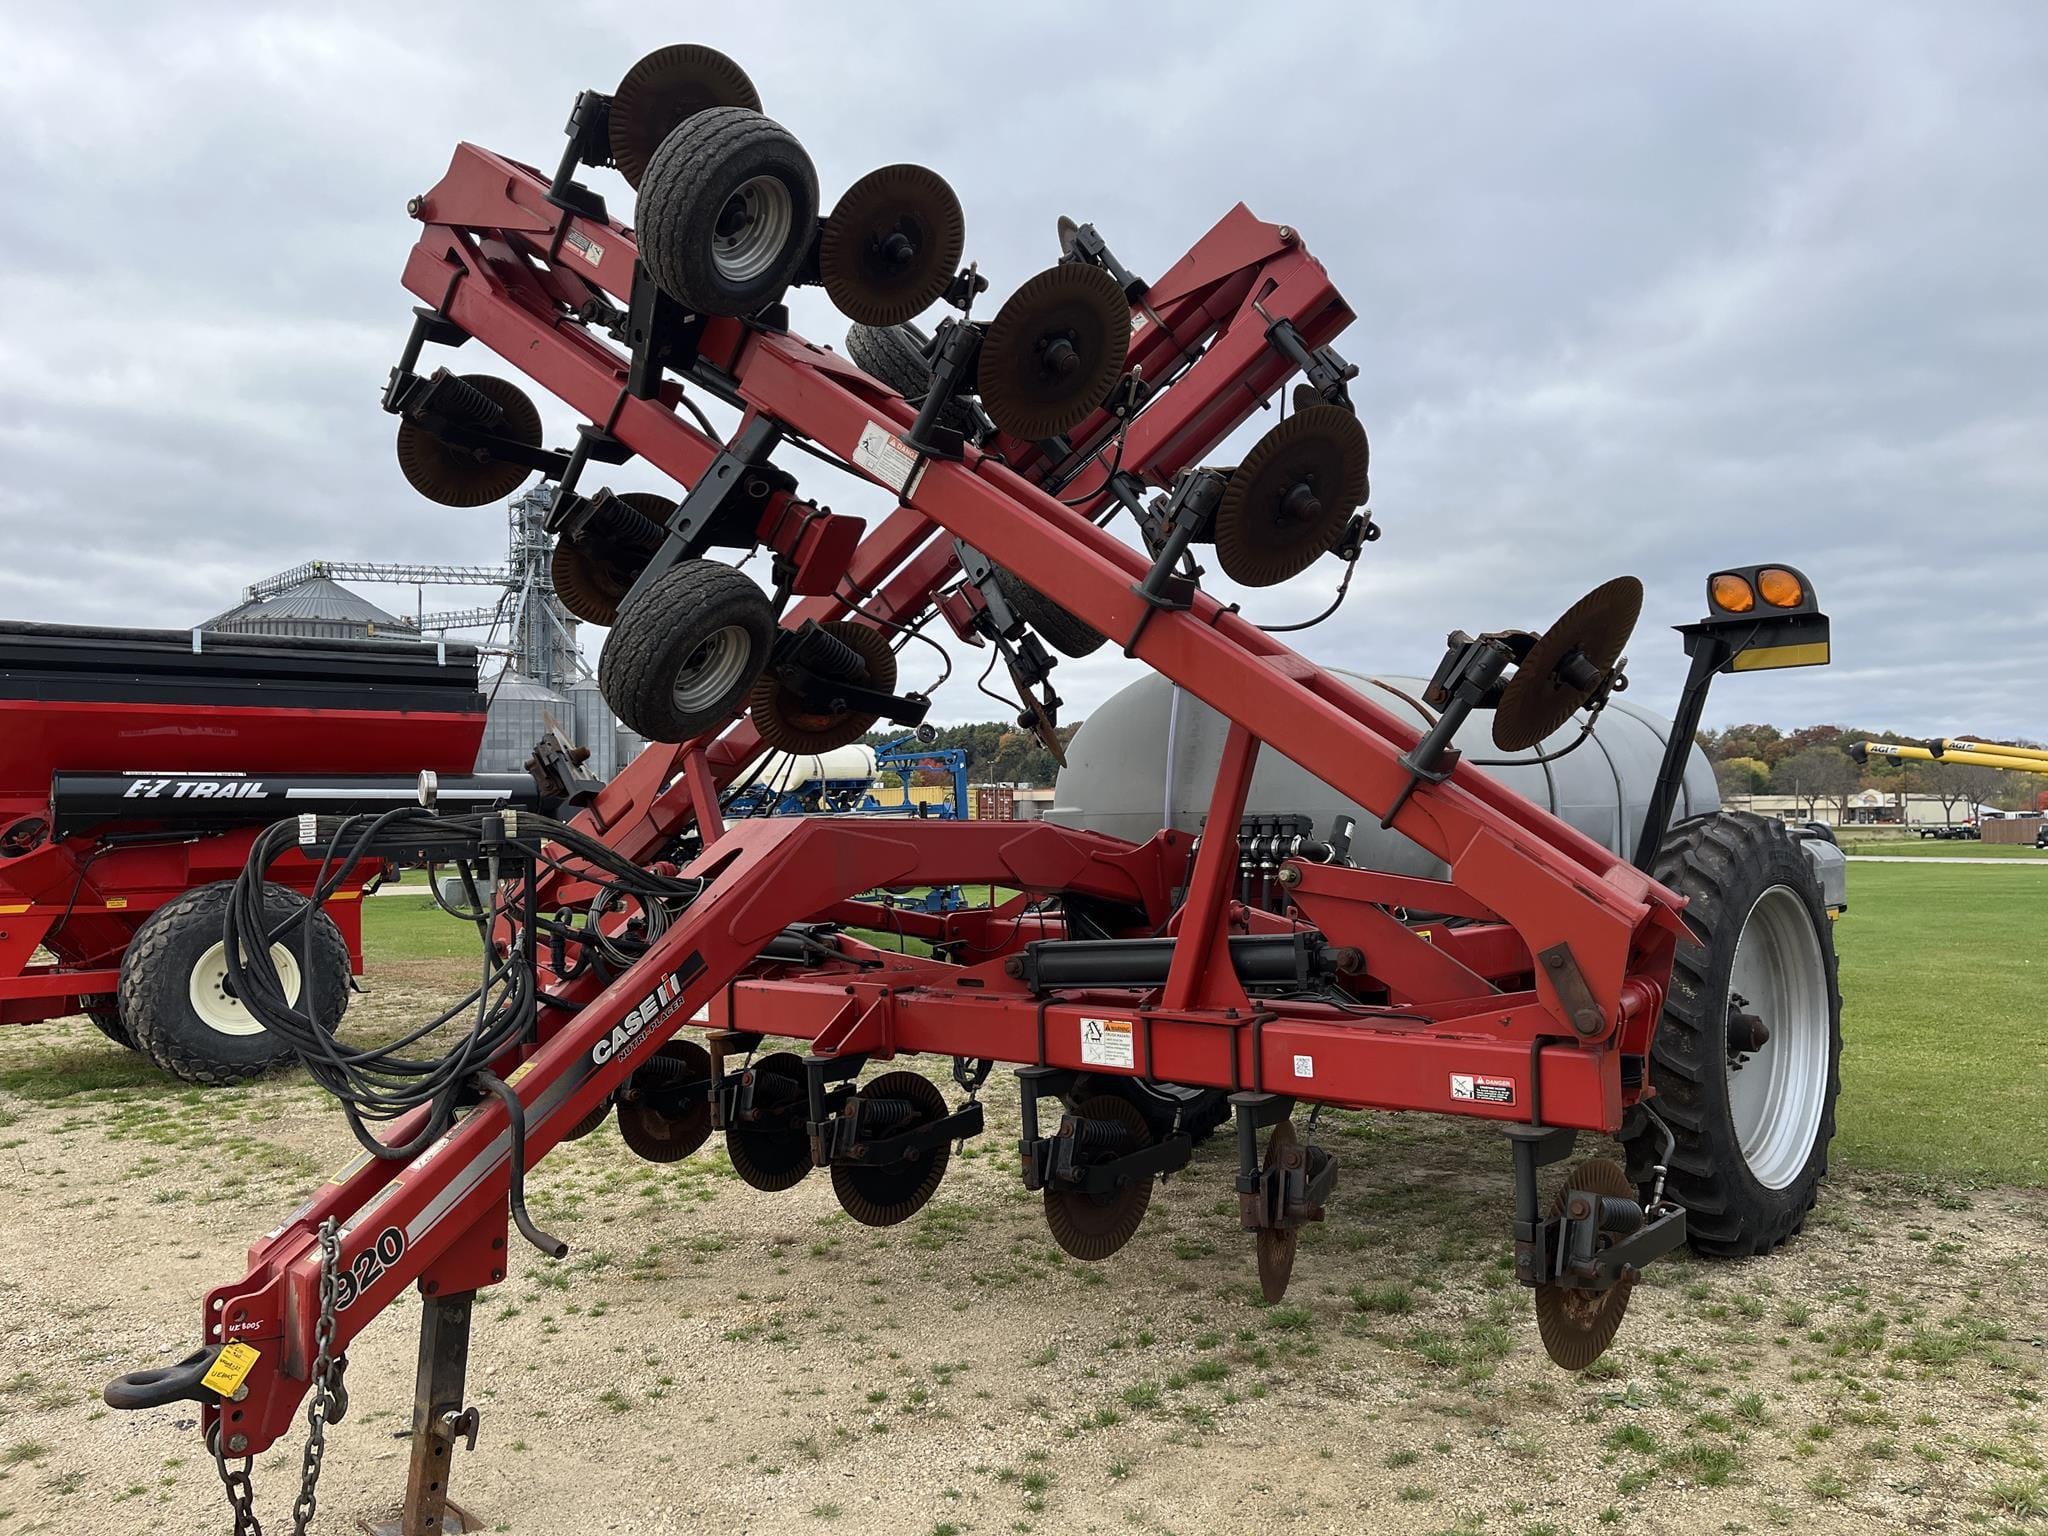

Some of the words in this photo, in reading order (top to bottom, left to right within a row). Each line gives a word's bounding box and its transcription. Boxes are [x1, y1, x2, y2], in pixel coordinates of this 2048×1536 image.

[123, 779, 171, 798] E-Z
[172, 782, 269, 798] TRAIL
[592, 994, 659, 1065] CASE
[618, 996, 685, 1062] NUTRI-PLACER
[1485, 1079, 1511, 1087] DANGER
[334, 1226, 405, 1312] 920
